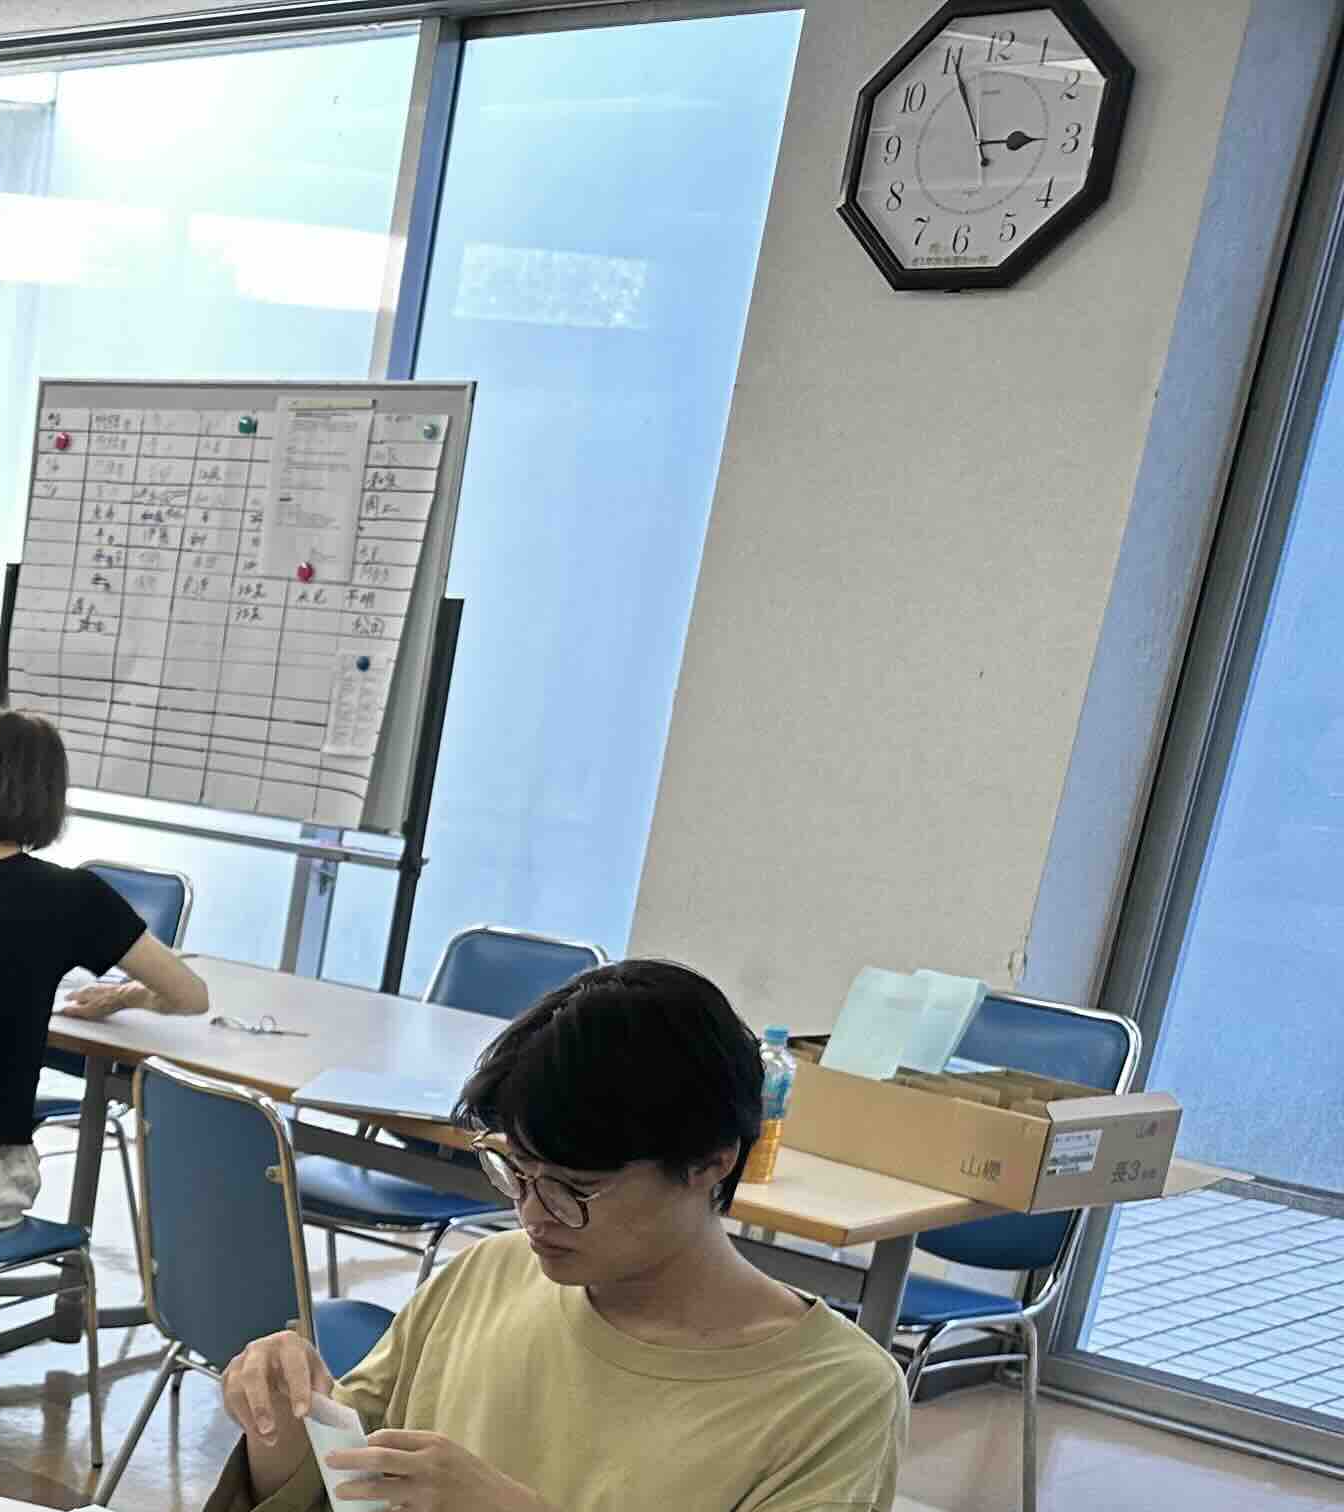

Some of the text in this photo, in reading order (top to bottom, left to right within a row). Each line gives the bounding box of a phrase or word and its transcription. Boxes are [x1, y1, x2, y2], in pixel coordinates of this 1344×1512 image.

[984, 30, 1016, 61] 12
[1040, 36, 1048, 65] 1
[899, 82, 927, 113] 10
[1060, 71, 1081, 101] 2
[883, 135, 901, 164] 9
[1060, 123, 1081, 154] 3
[885, 181, 904, 212] 8
[1035, 176, 1054, 208] 4
[914, 216, 930, 246] 7
[952, 224, 971, 255] 6
[1000, 213, 1016, 242] 5
